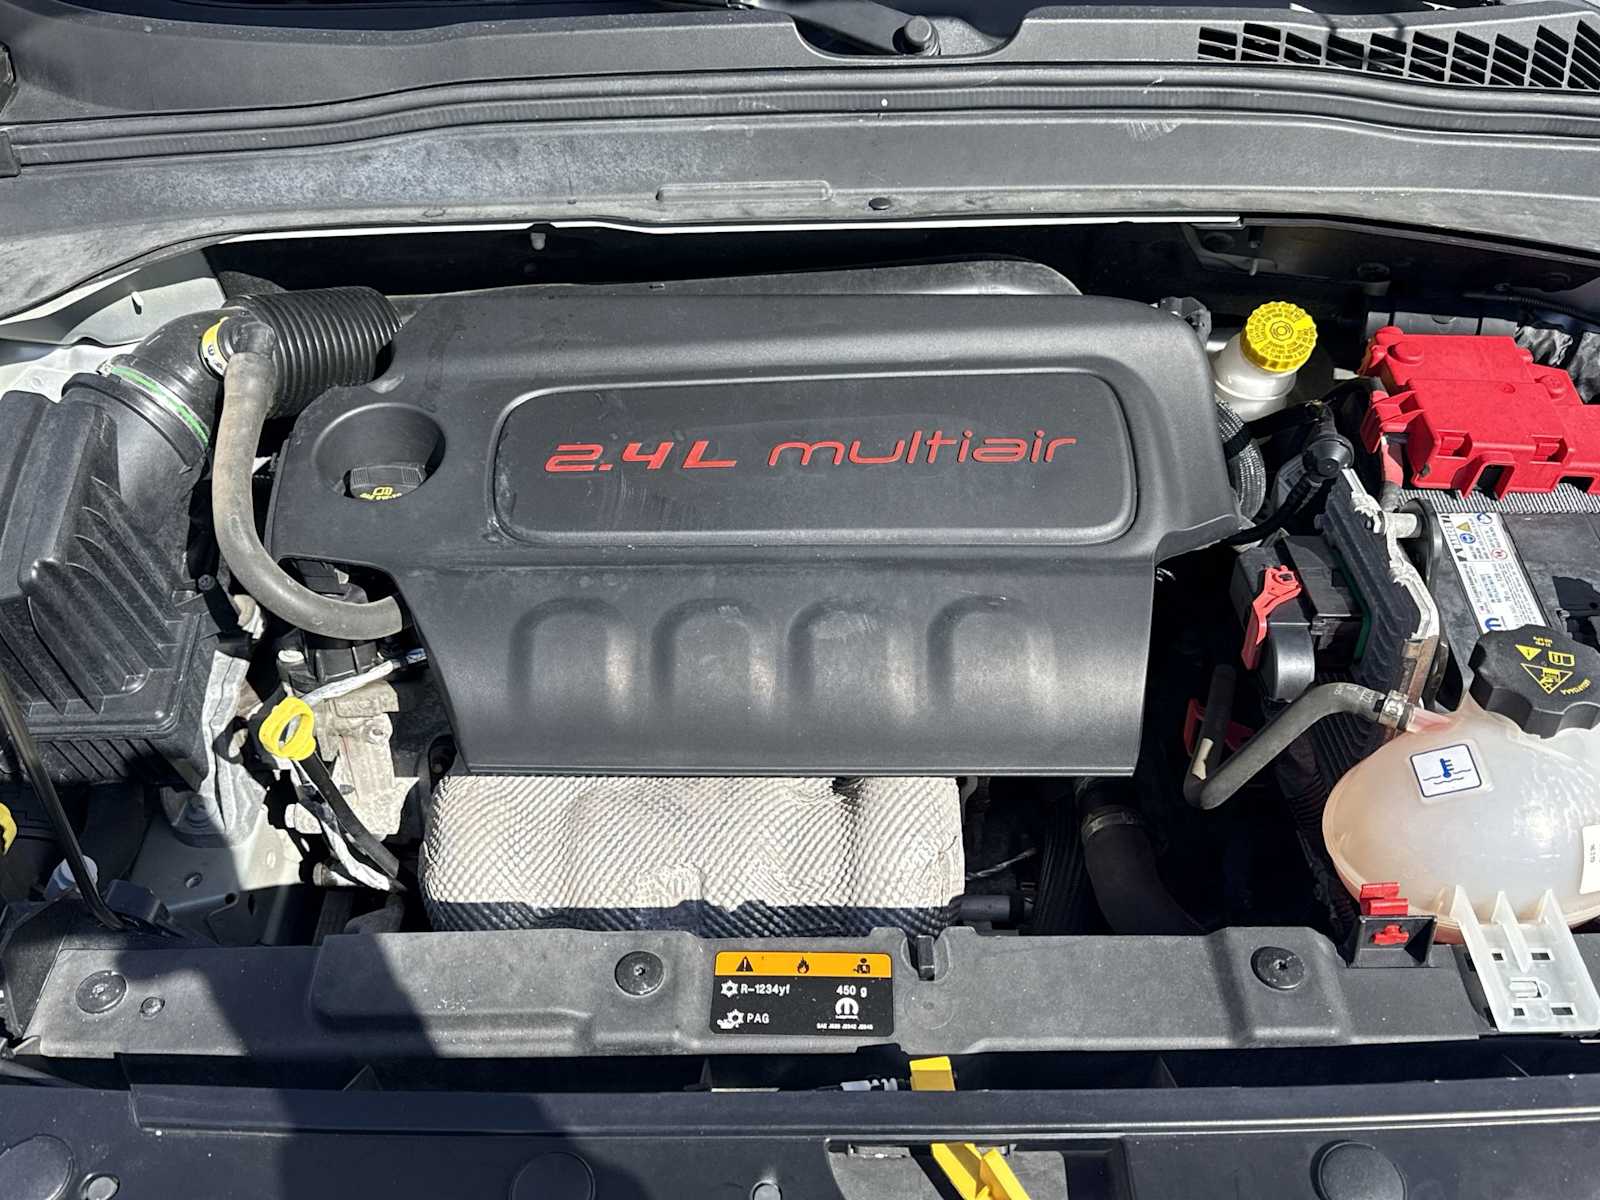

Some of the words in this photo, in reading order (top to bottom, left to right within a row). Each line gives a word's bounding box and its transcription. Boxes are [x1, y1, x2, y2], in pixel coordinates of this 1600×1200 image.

[545, 440, 737, 472] 2.4L
[769, 430, 1076, 465] multiair
[740, 984, 790, 997] R-1234yf
[836, 984, 856, 996] 450
[860, 986, 868, 998] g
[746, 1013, 770, 1024] PAG
